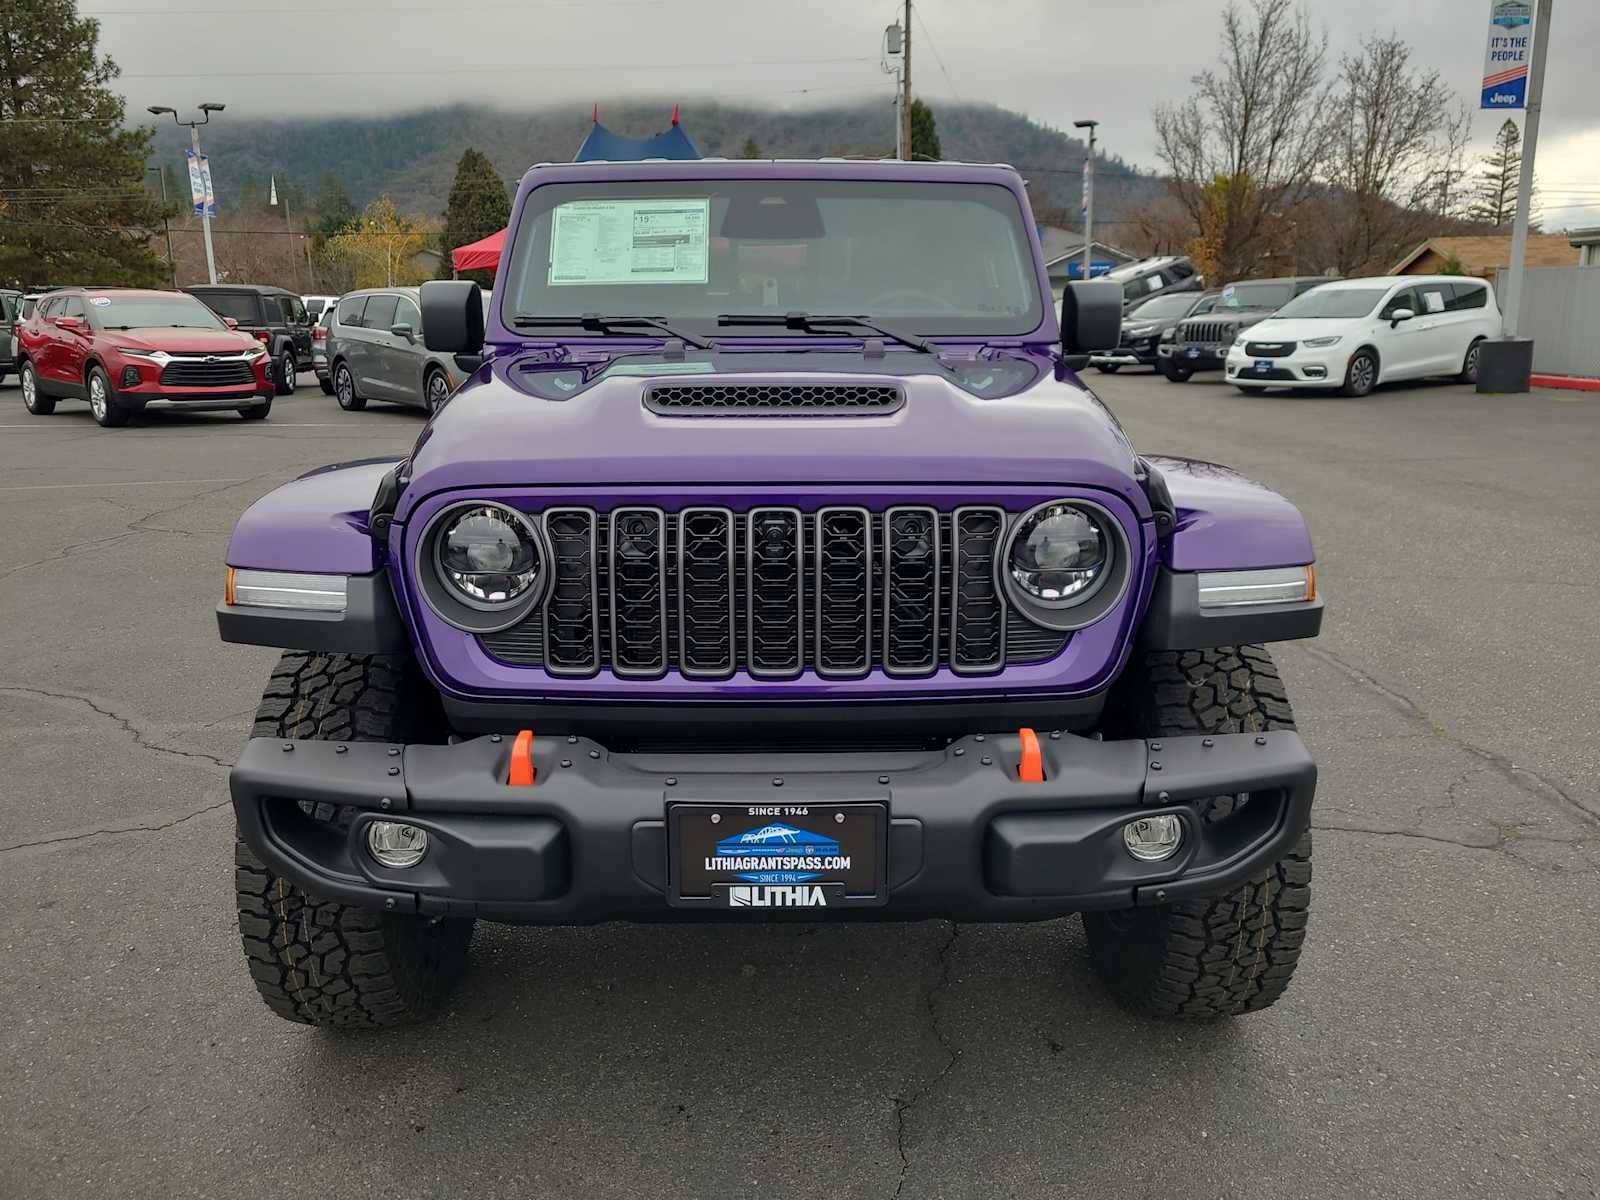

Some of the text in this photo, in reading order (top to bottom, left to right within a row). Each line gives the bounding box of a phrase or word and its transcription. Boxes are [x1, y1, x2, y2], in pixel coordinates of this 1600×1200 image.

[1491, 37, 1528, 48] IT'S THE
[1491, 50, 1525, 61] PEOPLE
[1490, 92, 1517, 105] Jeep
[748, 807, 809, 816] SINCE 1946
[705, 856, 851, 871] LITHIAGRANTSPASS.COM
[759, 874, 797, 883] SINCE 1994
[751, 886, 827, 907] LITHIA
